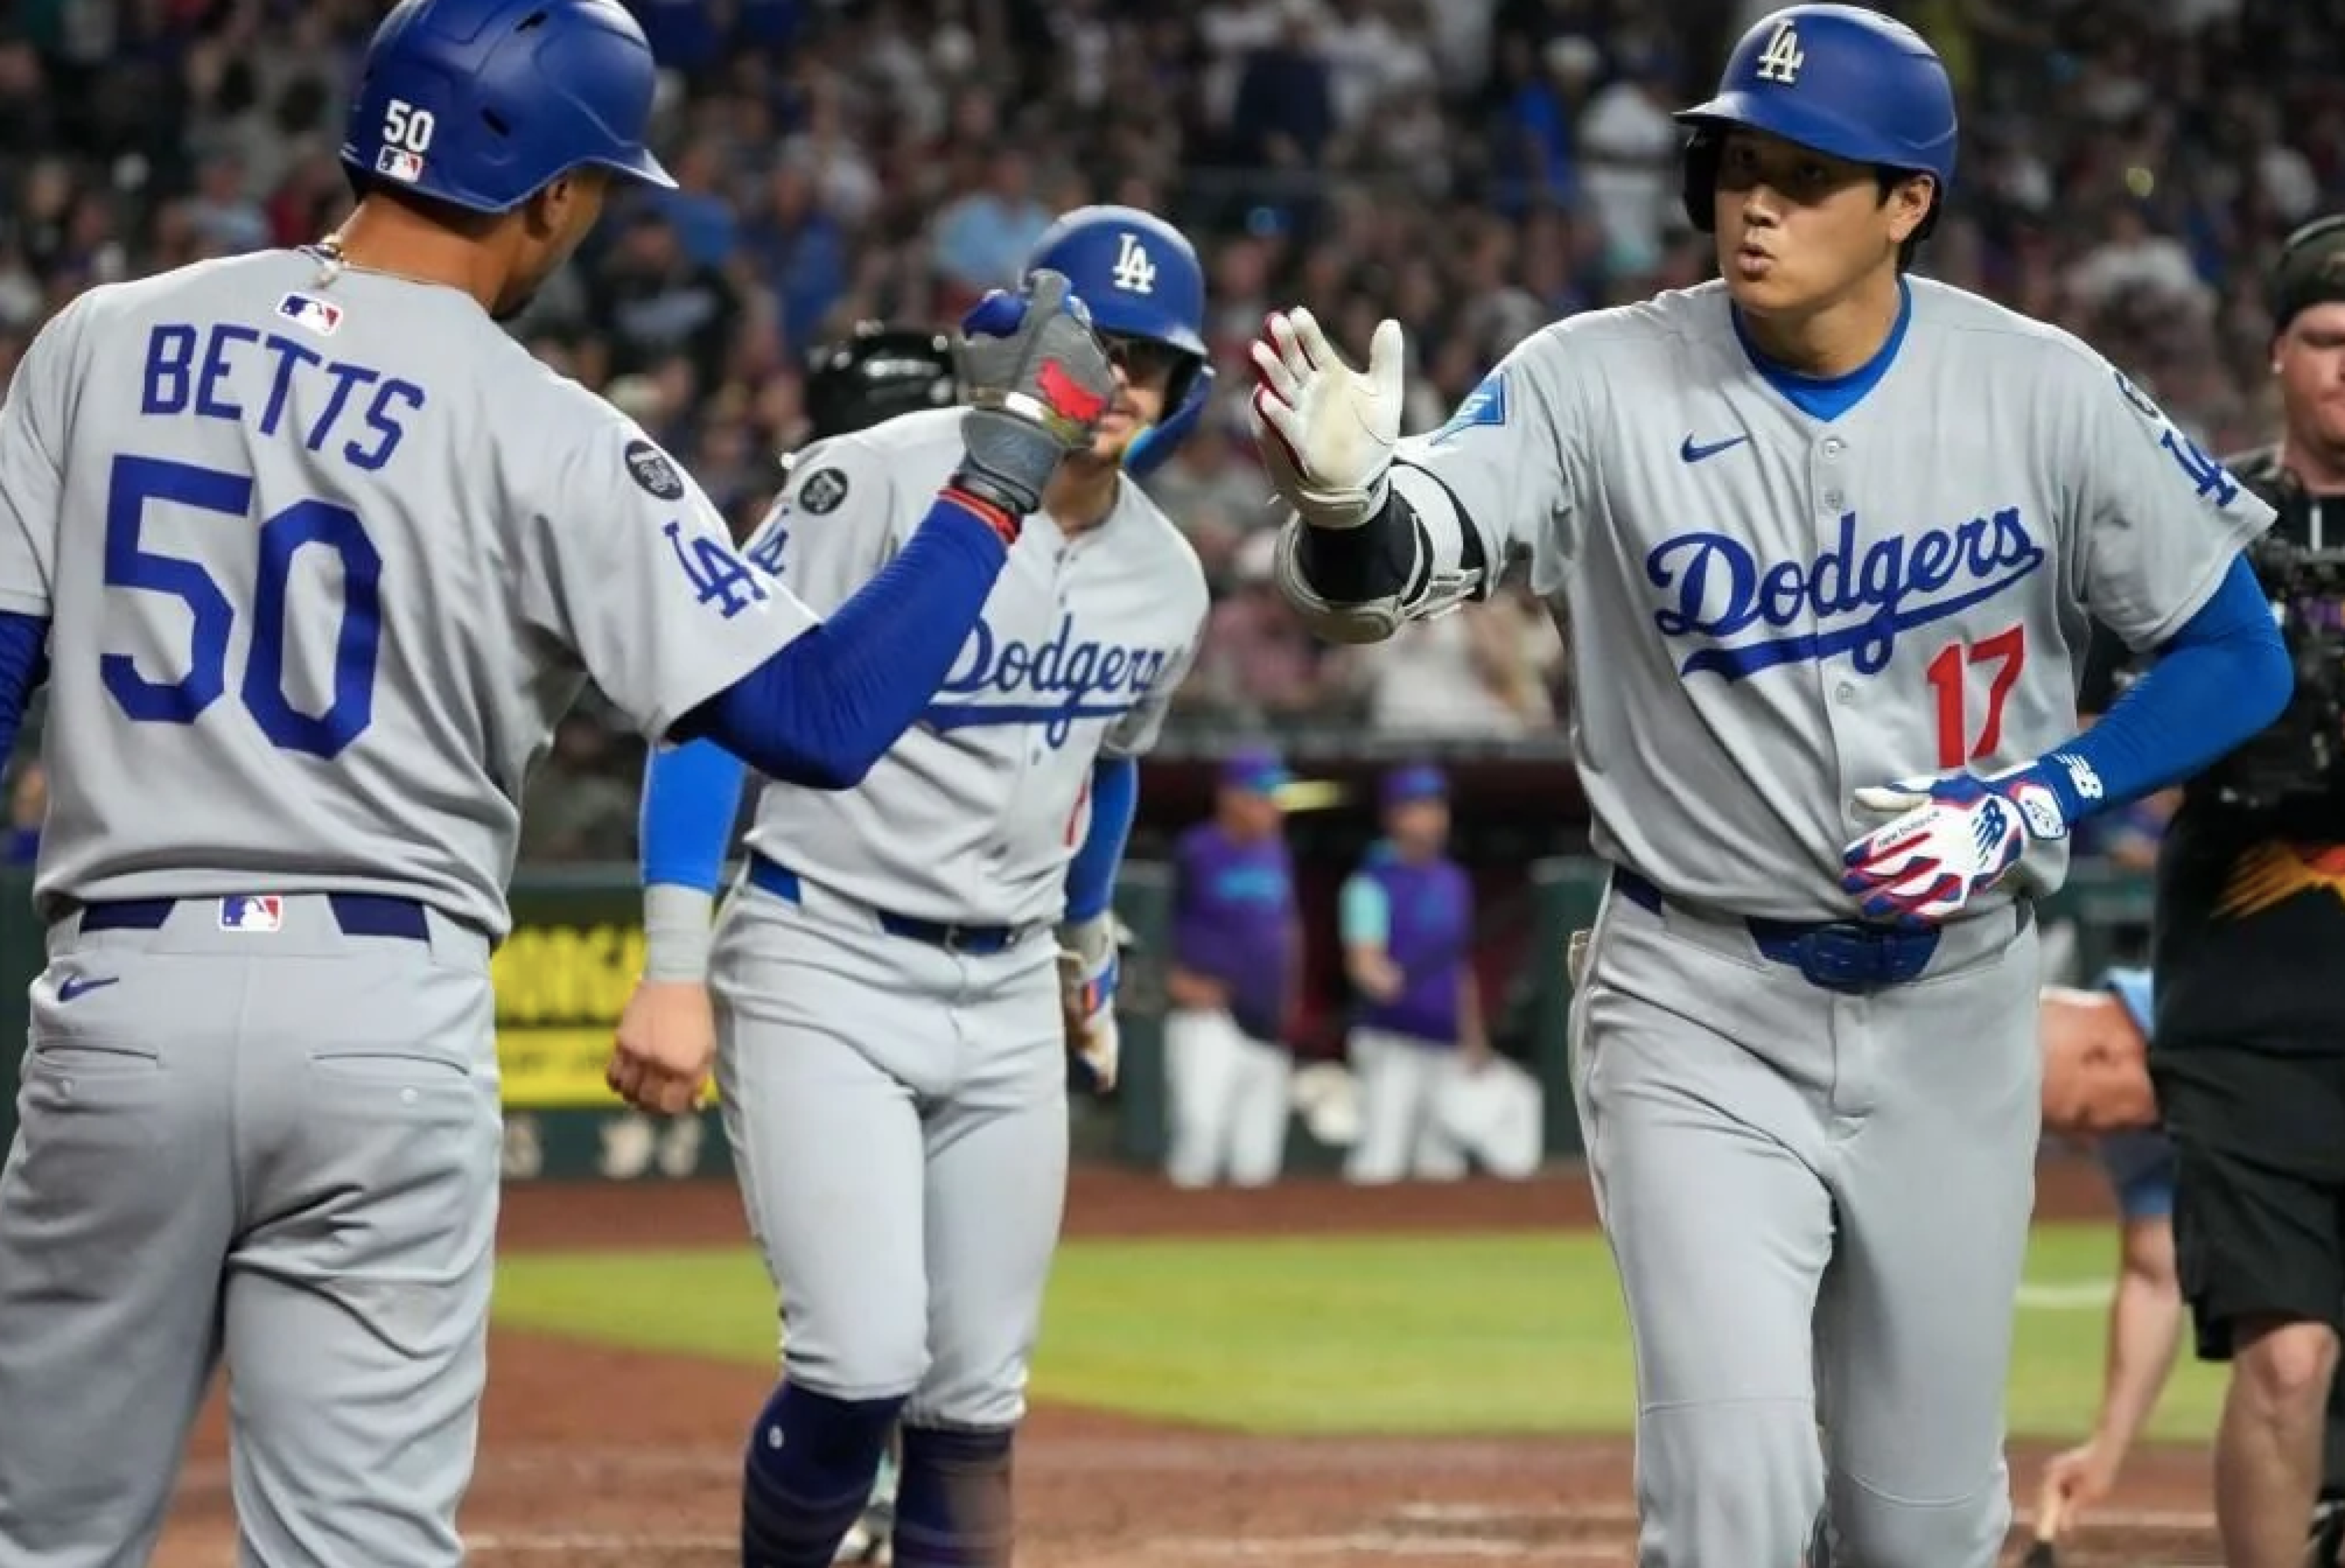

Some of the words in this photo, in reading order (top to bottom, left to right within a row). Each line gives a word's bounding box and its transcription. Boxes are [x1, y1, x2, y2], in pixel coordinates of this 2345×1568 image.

[1757, 18, 1805, 83] LA
[383, 98, 435, 152] 50
[1113, 232, 1156, 294] LA
[141, 323, 427, 472] BETTS
[99, 453, 383, 761] 50
[662, 520, 769, 619] LA
[1646, 506, 2045, 676] Dodgers
[1925, 622, 2025, 769] 17
